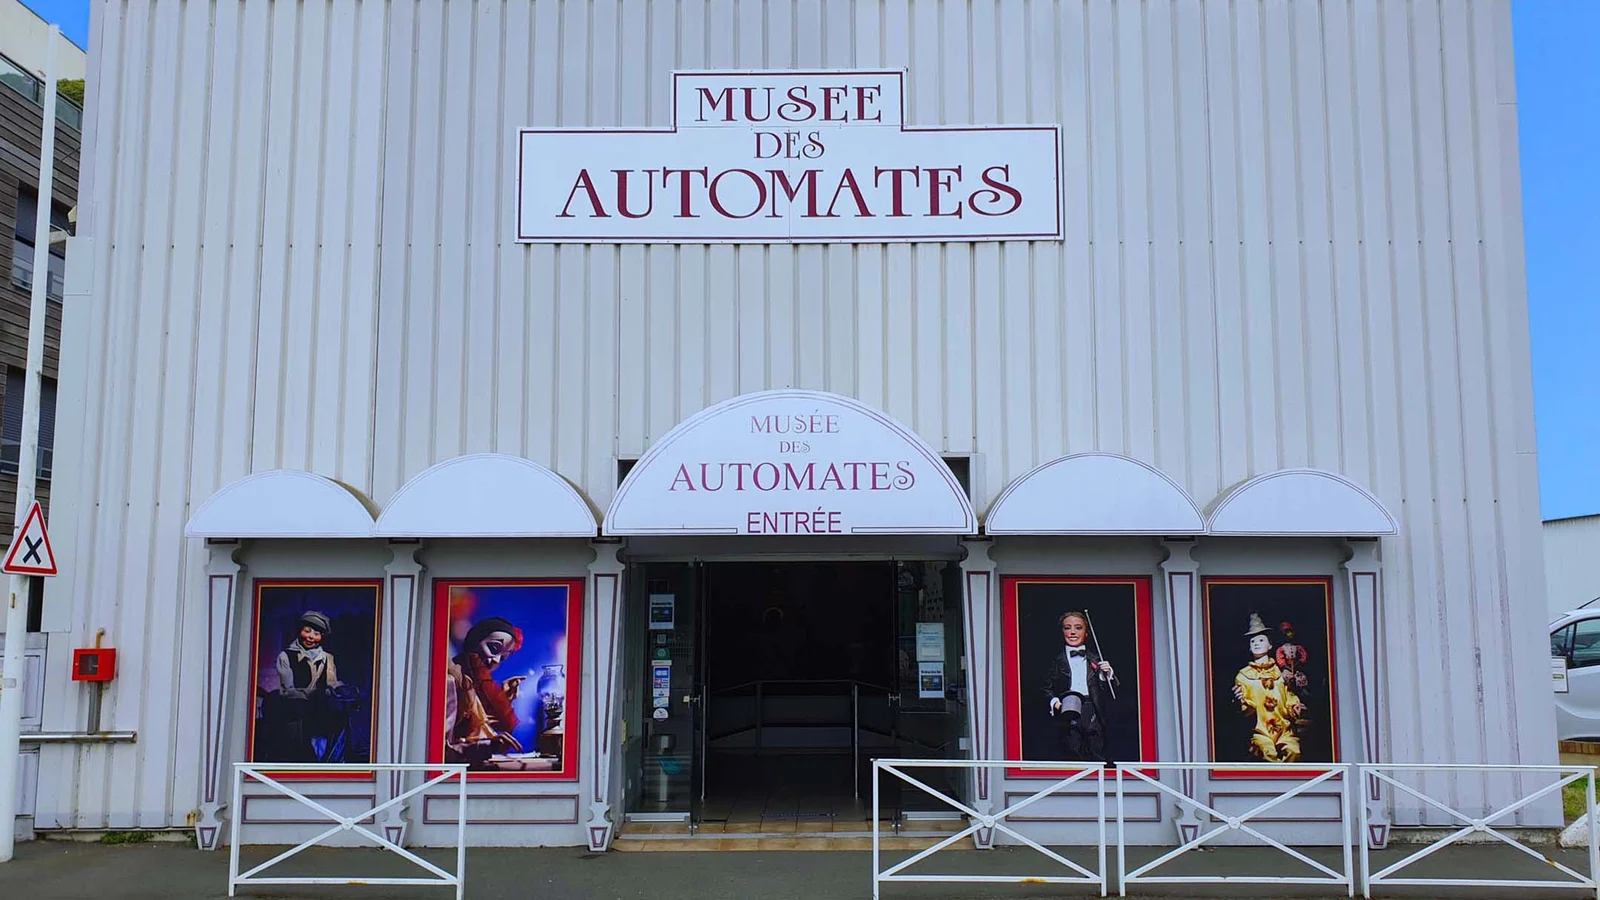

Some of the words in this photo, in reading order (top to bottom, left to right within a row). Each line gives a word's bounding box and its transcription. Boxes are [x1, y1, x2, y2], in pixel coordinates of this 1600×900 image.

[695, 84, 882, 122] MUSEE
[754, 131, 825, 159] DES
[555, 164, 1022, 220] AUTOMATES
[750, 410, 840, 433] MUSÉE
[779, 441, 811, 454] DES
[668, 460, 916, 492] AUTOMATES
[747, 507, 842, 534] ENTRÉE
